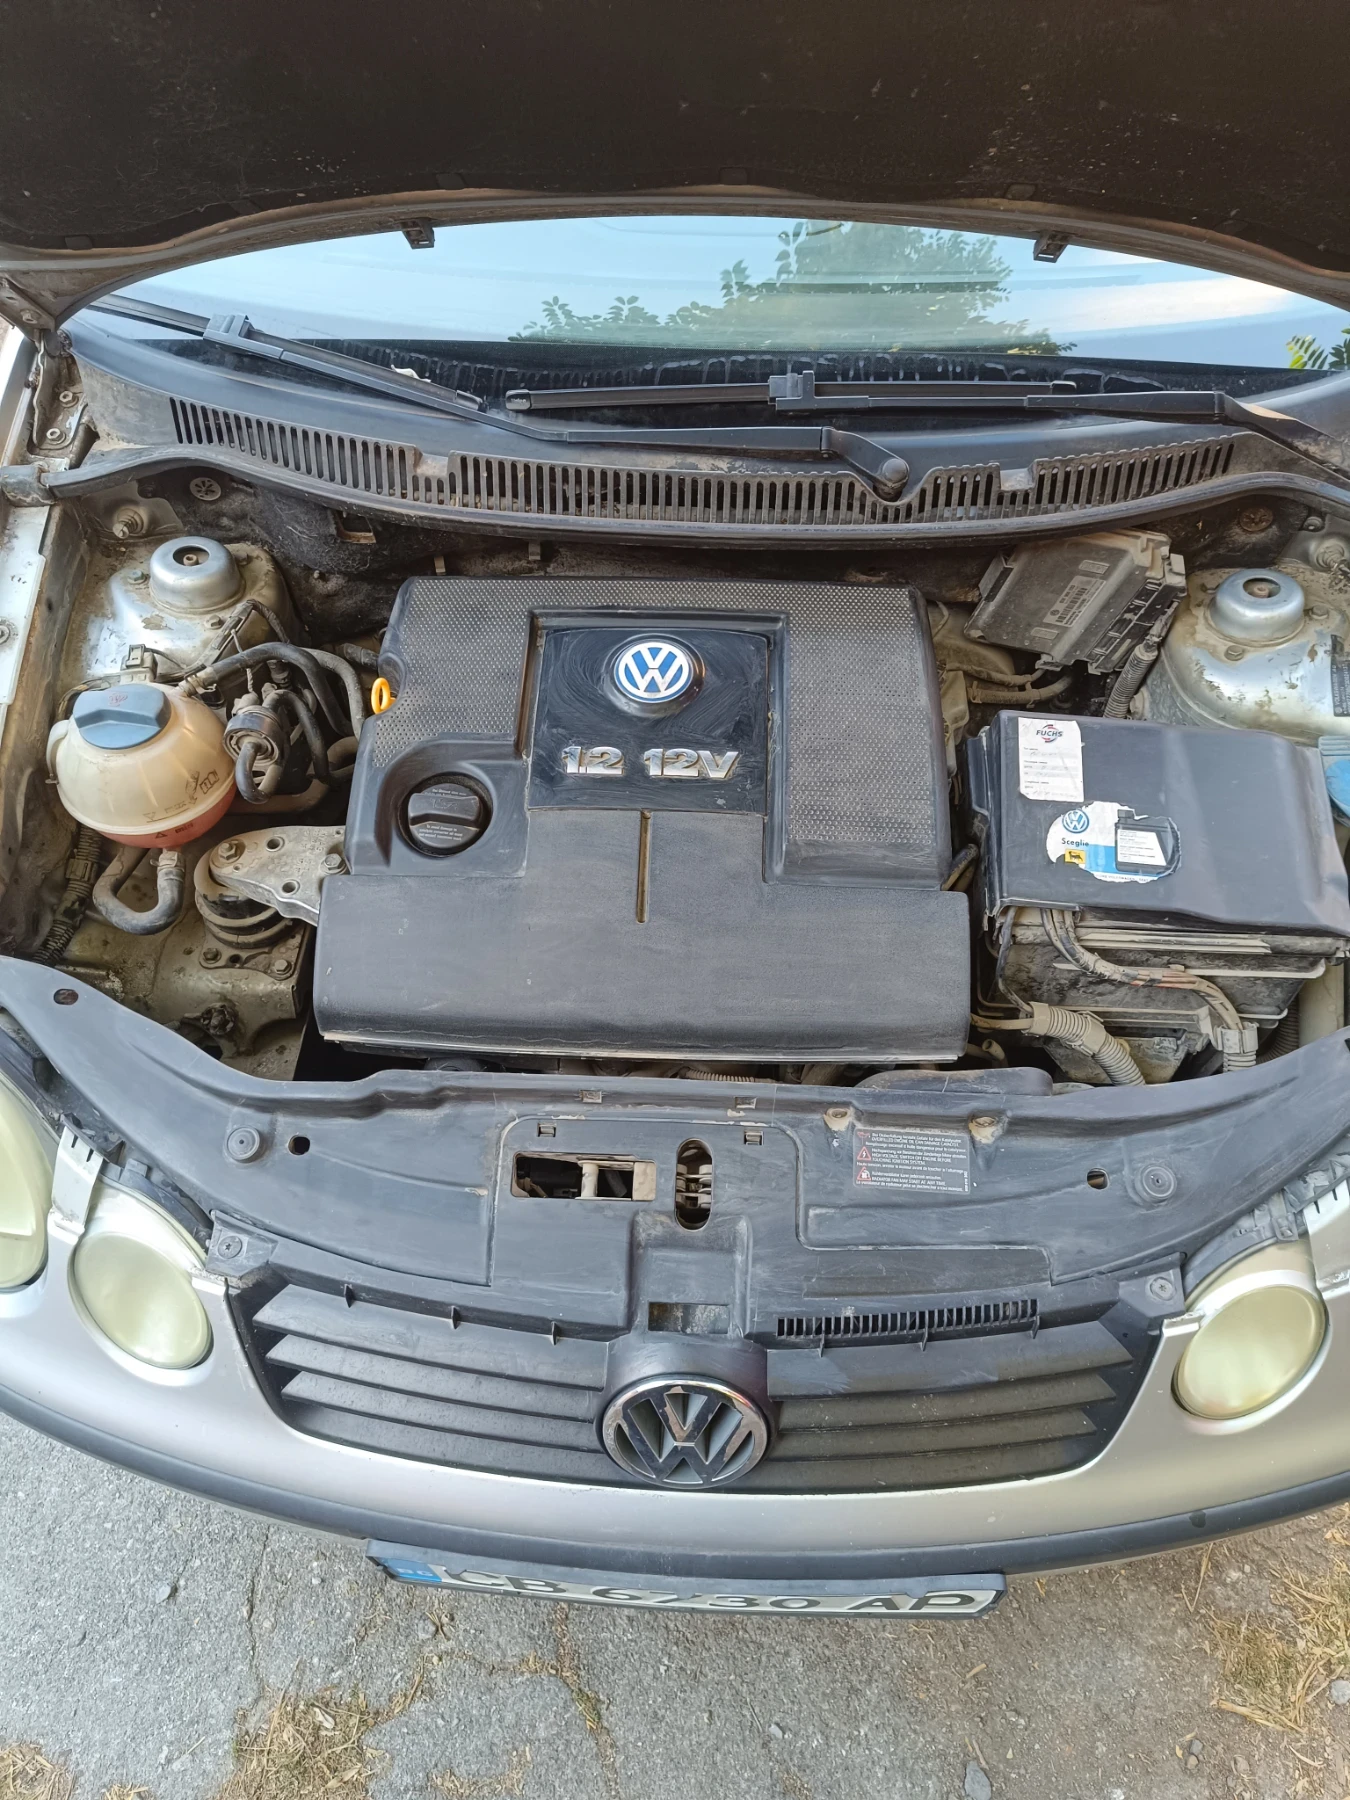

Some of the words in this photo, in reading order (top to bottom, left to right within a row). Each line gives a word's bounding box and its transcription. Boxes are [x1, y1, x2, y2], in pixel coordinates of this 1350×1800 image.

[617, 642, 690, 699] VW
[1036, 730, 1064, 738] FUCHS
[644, 748, 739, 779] 12V
[604, 1381, 767, 1489] VW
[444, 1569, 567, 1594] CB
[592, 1587, 821, 1609] 6730
[846, 1593, 976, 1611] AP
